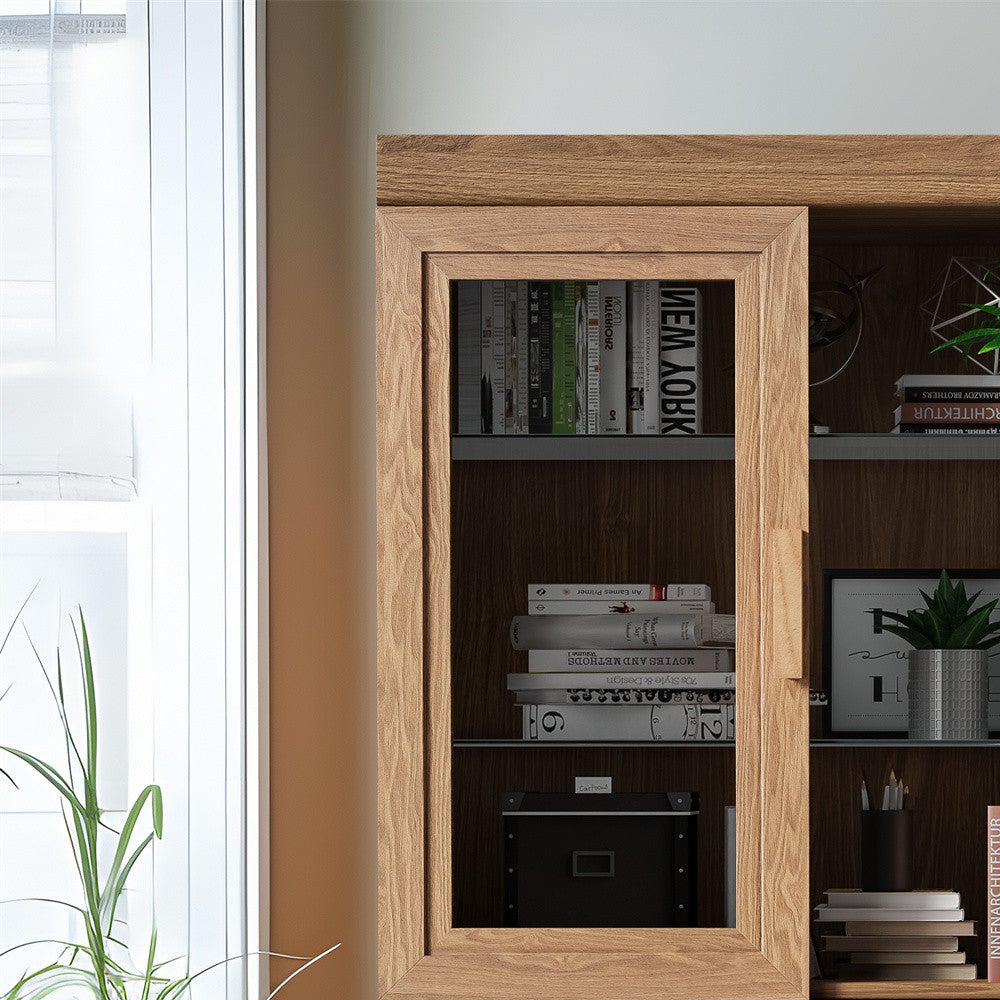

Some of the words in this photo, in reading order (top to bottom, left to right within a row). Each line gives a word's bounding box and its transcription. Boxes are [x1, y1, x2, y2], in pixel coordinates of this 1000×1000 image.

[576, 588, 602, 596] Primer
[604, 588, 630, 596] Eames
[631, 588, 642, 596] An
[568, 657, 620, 666] METHODS
[622, 657, 646, 666] AND
[649, 657, 695, 666] MOVIES
[606, 676, 642, 686] Design
[655, 676, 680, 686] Style
[680, 676, 698, 685] 70s
[542, 711, 565, 734] 6
[700, 706, 722, 740] 12
